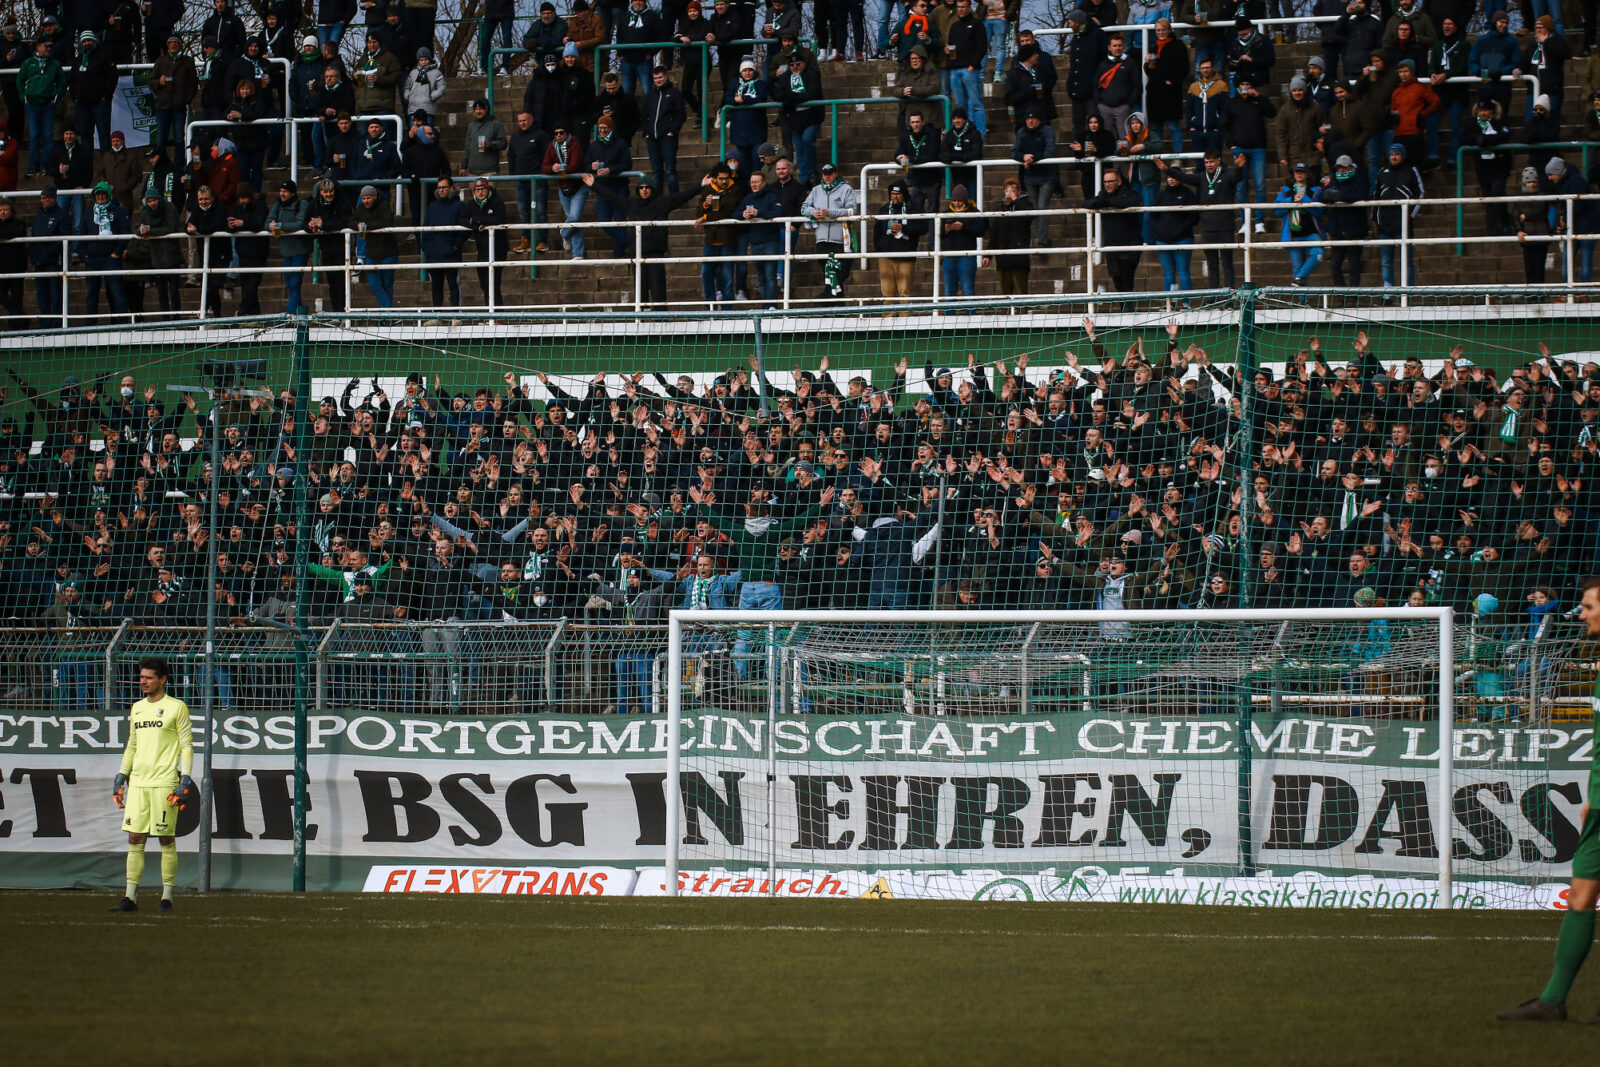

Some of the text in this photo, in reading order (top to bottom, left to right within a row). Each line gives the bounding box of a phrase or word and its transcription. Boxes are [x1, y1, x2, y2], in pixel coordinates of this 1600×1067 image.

[0, 715, 1056, 756] TRIBSSPORTGEMEINSCHAFT
[1078, 719, 1376, 757] CHEMIE
[0, 768, 77, 838] T
[354, 770, 589, 847] BSG
[625, 772, 746, 845] IN
[788, 773, 1211, 858] EHREN,
[1262, 775, 1583, 863] DASS
[162, 811, 167, 823] 1
[1119, 881, 1486, 910] wwwklassik-hausbootde
